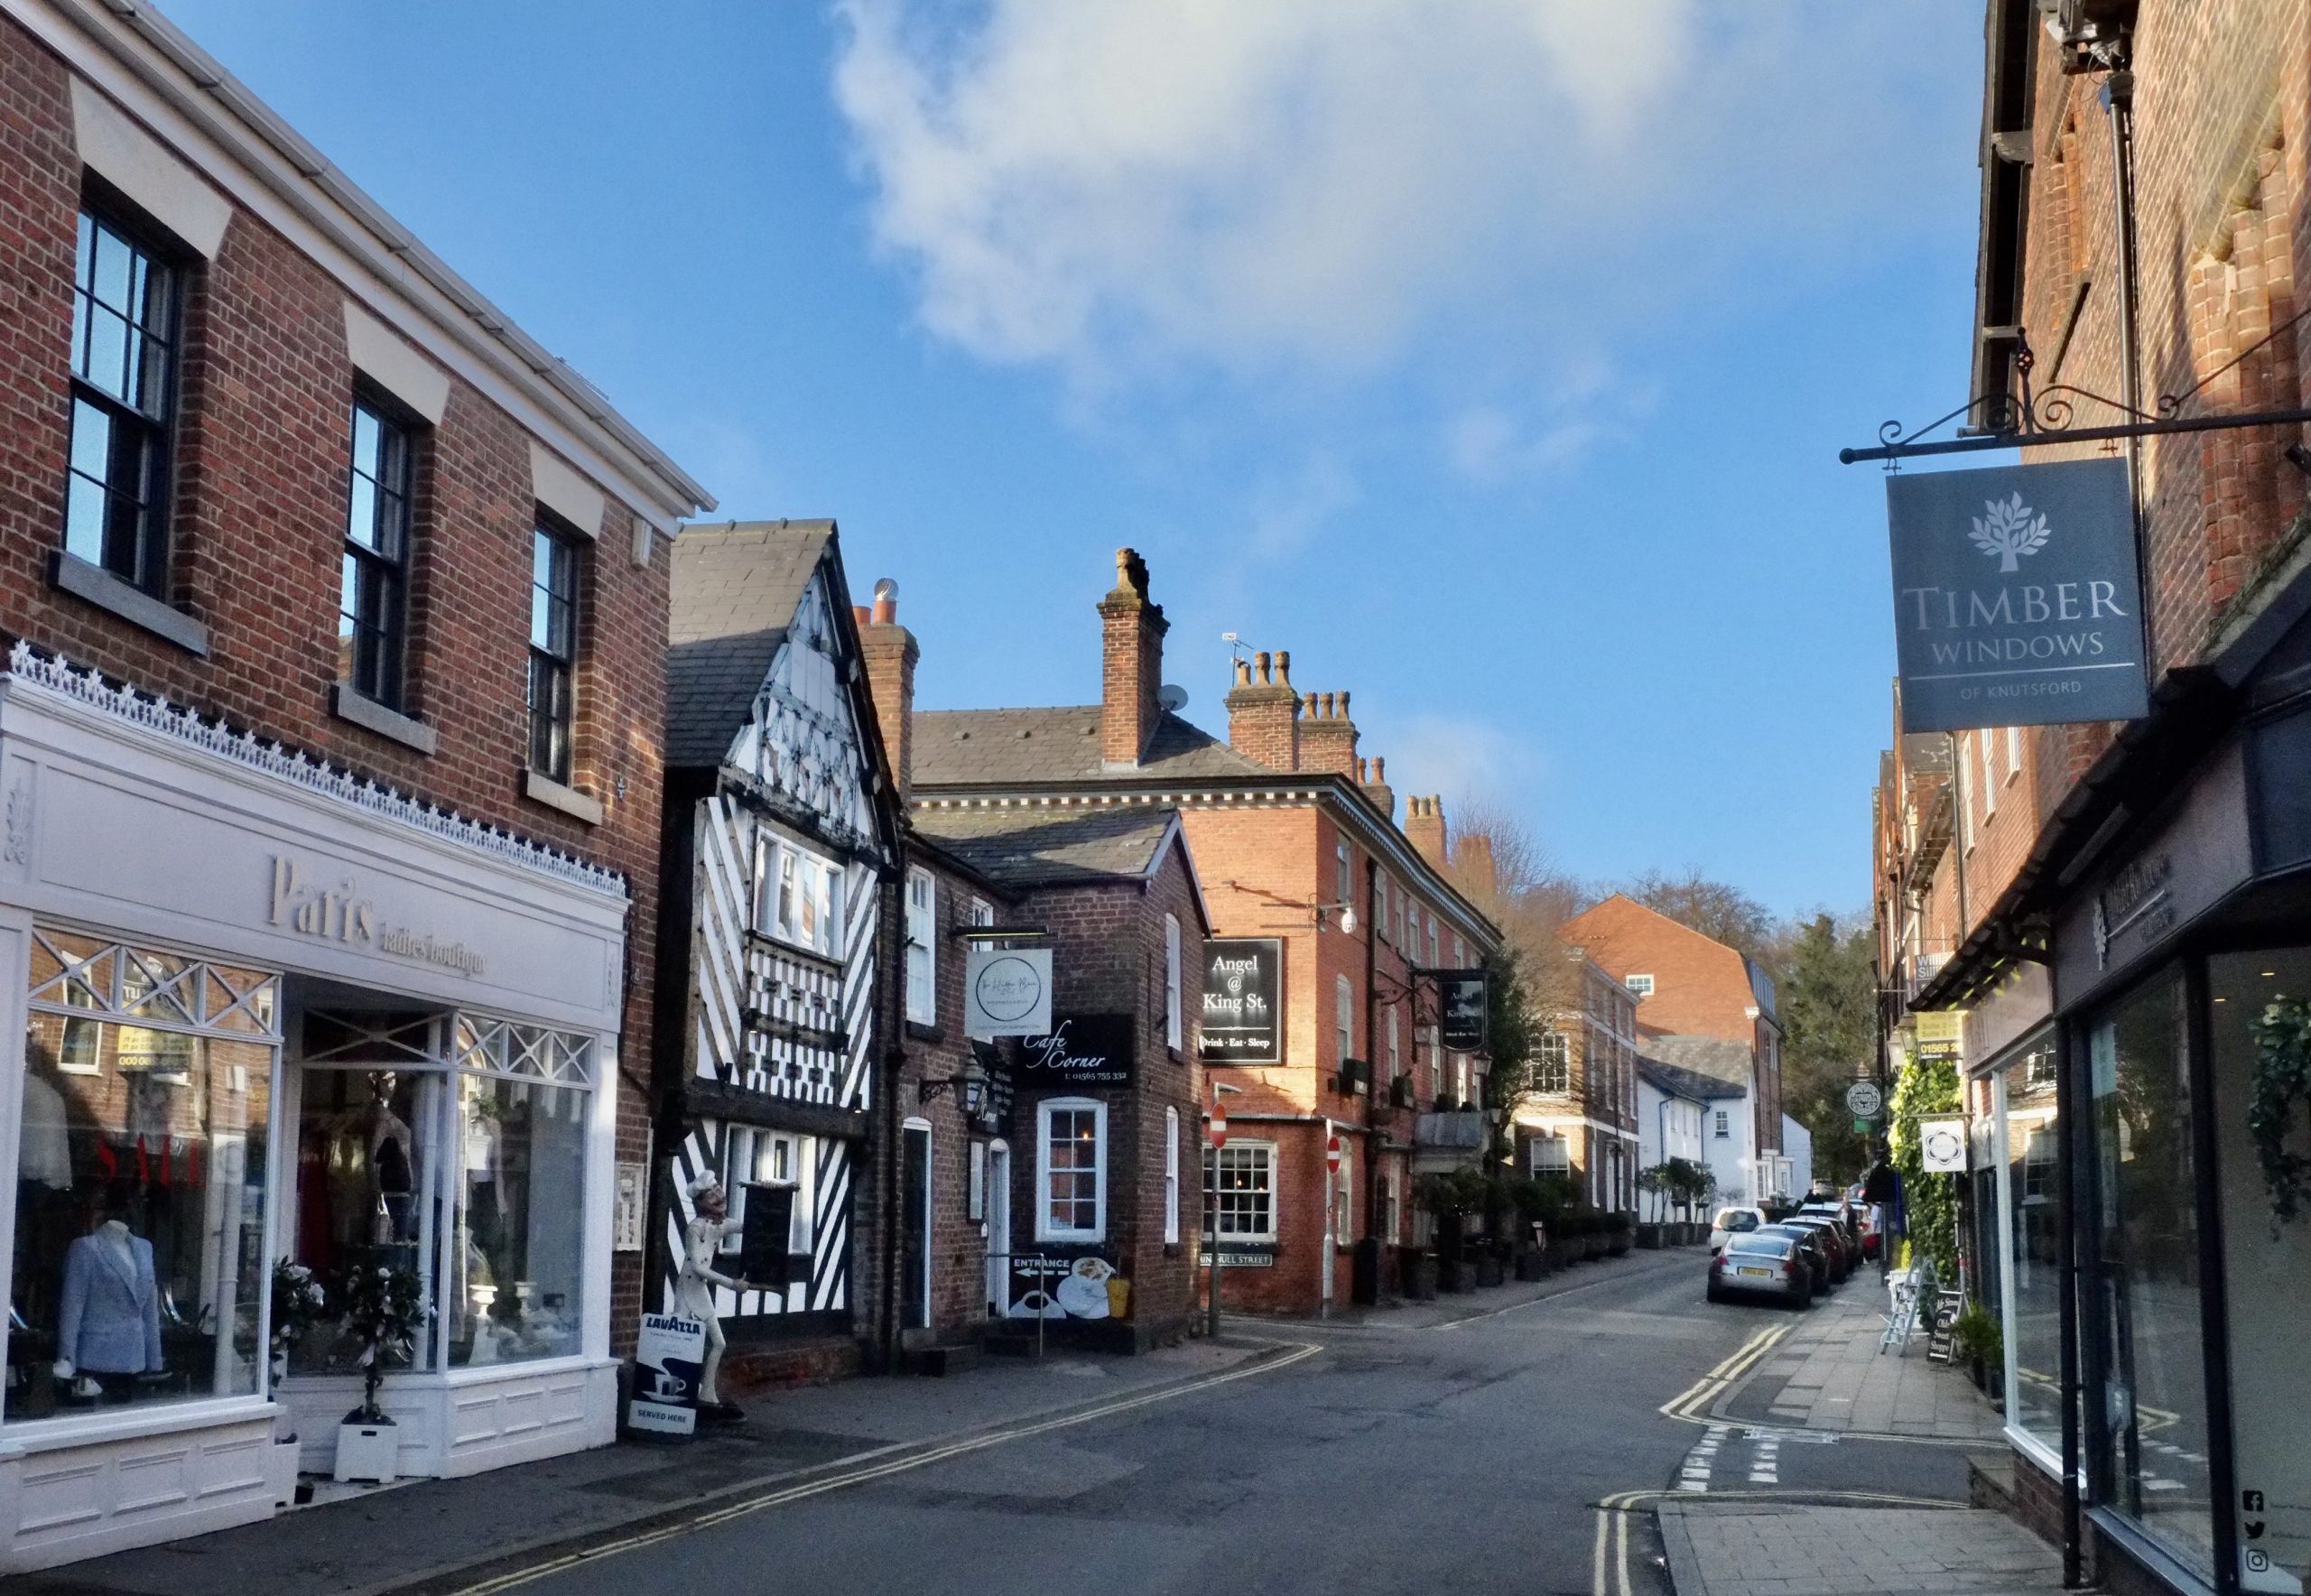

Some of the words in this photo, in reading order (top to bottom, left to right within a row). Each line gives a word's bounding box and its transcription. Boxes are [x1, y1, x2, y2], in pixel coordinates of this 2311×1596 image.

[1902, 580, 2129, 630] TIMBER
[1932, 632, 2104, 664] WINDOWS
[1961, 688, 1981, 701] OF
[1987, 681, 2082, 700] KNUTSFORD
[1211, 955, 1258, 975] Angel
[1228, 976, 1242, 992] @
[1202, 993, 1243, 1013] King
[1246, 993, 1267, 1009] St.
[1452, 992, 1472, 1000] Angel
[1023, 1019, 1072, 1069] Cafe
[1229, 1037, 1243, 1047] Eat
[1248, 1037, 1270, 1049] Sleep
[1920, 1044, 1949, 1053] 01565
[1048, 1050, 1106, 1069] Corner
[1072, 1072, 1096, 1081] 01565
[1097, 1072, 1111, 1081] 755
[1112, 1072, 1127, 1081] 332
[1014, 1258, 1070, 1267] ENTRANCE
[1199, 1256, 1237, 1264] MINHULL
[1239, 1256, 1269, 1264] STREET
[645, 1316, 701, 1335] LAVAZZA
[637, 1409, 666, 1421] SERVED
[667, 1413, 687, 1424] HERE
